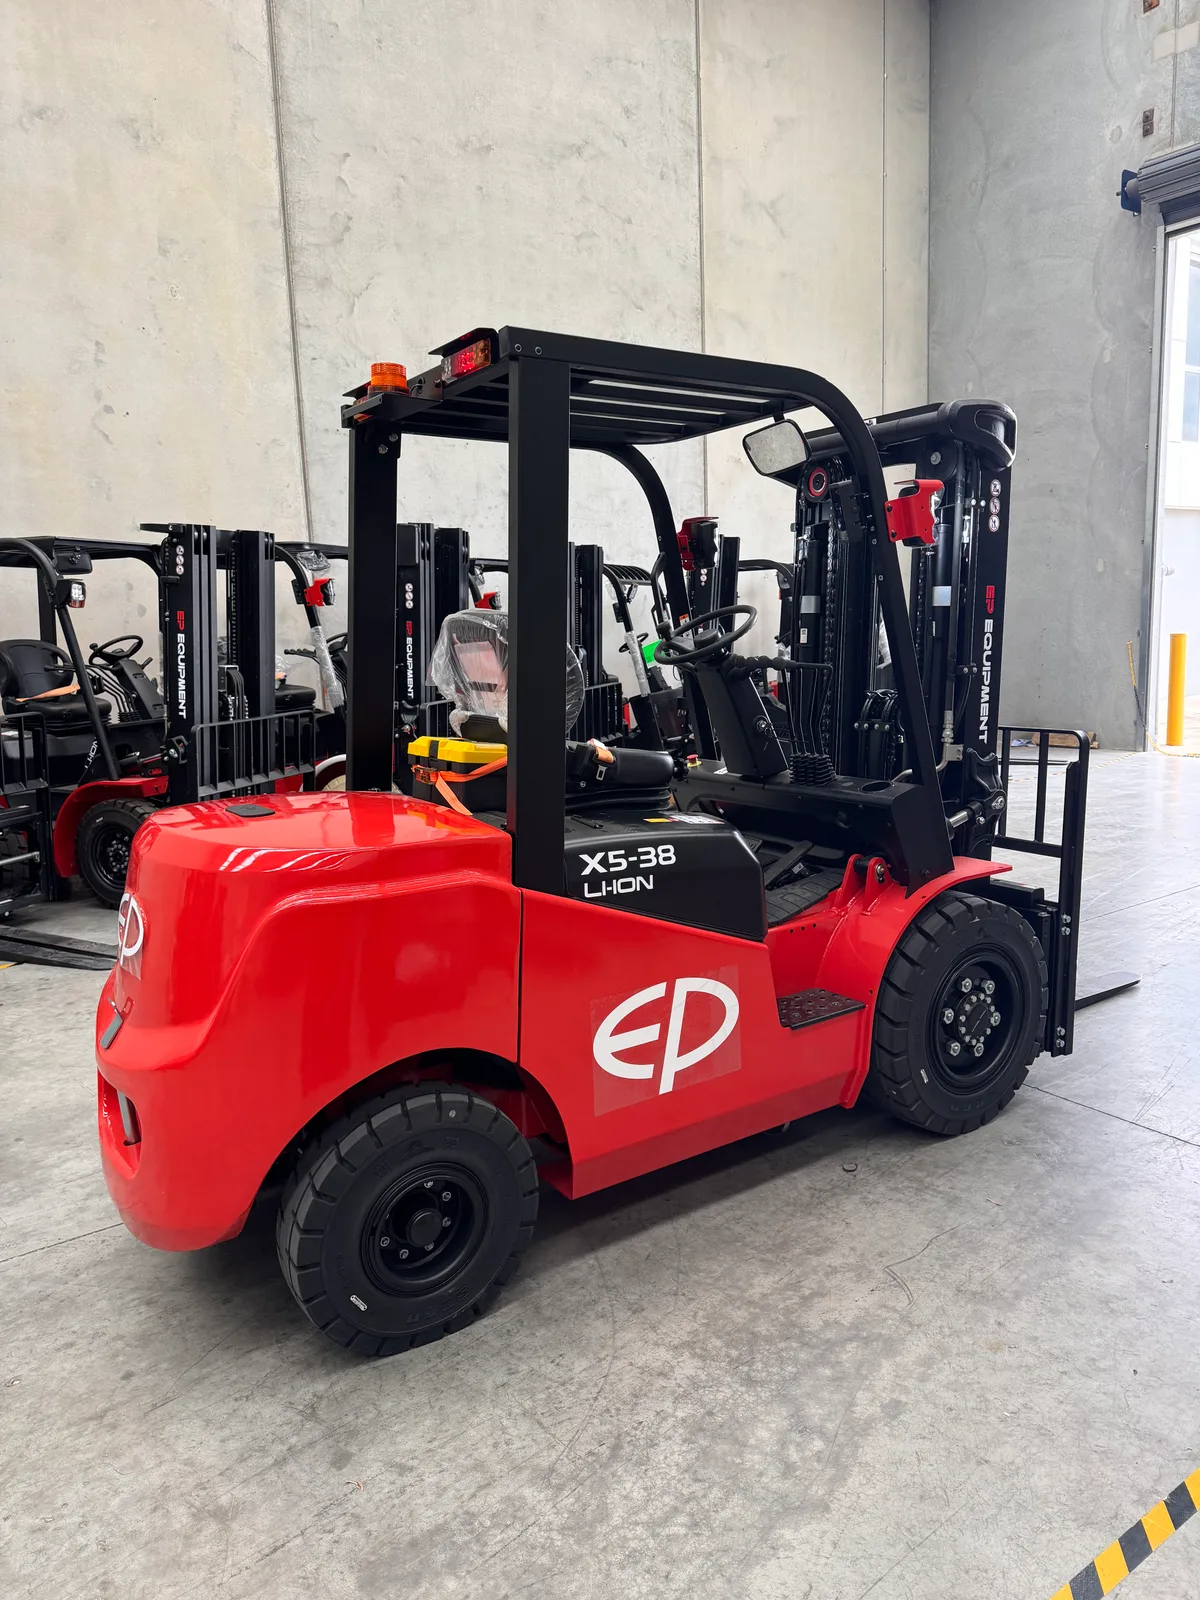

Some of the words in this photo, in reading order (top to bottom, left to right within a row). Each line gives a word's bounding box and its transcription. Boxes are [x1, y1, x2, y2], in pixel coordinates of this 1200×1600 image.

[986, 585, 995, 614] EP
[176, 610, 185, 631] EP
[405, 621, 413, 636] EP
[177, 633, 187, 719] EQUIPMENT
[406, 637, 415, 699] EQUIPMENT
[978, 619, 994, 744] EQUIPMENT
[579, 844, 676, 875] X5-38
[584, 874, 654, 898] LI-ION
[592, 977, 740, 1095] EP
